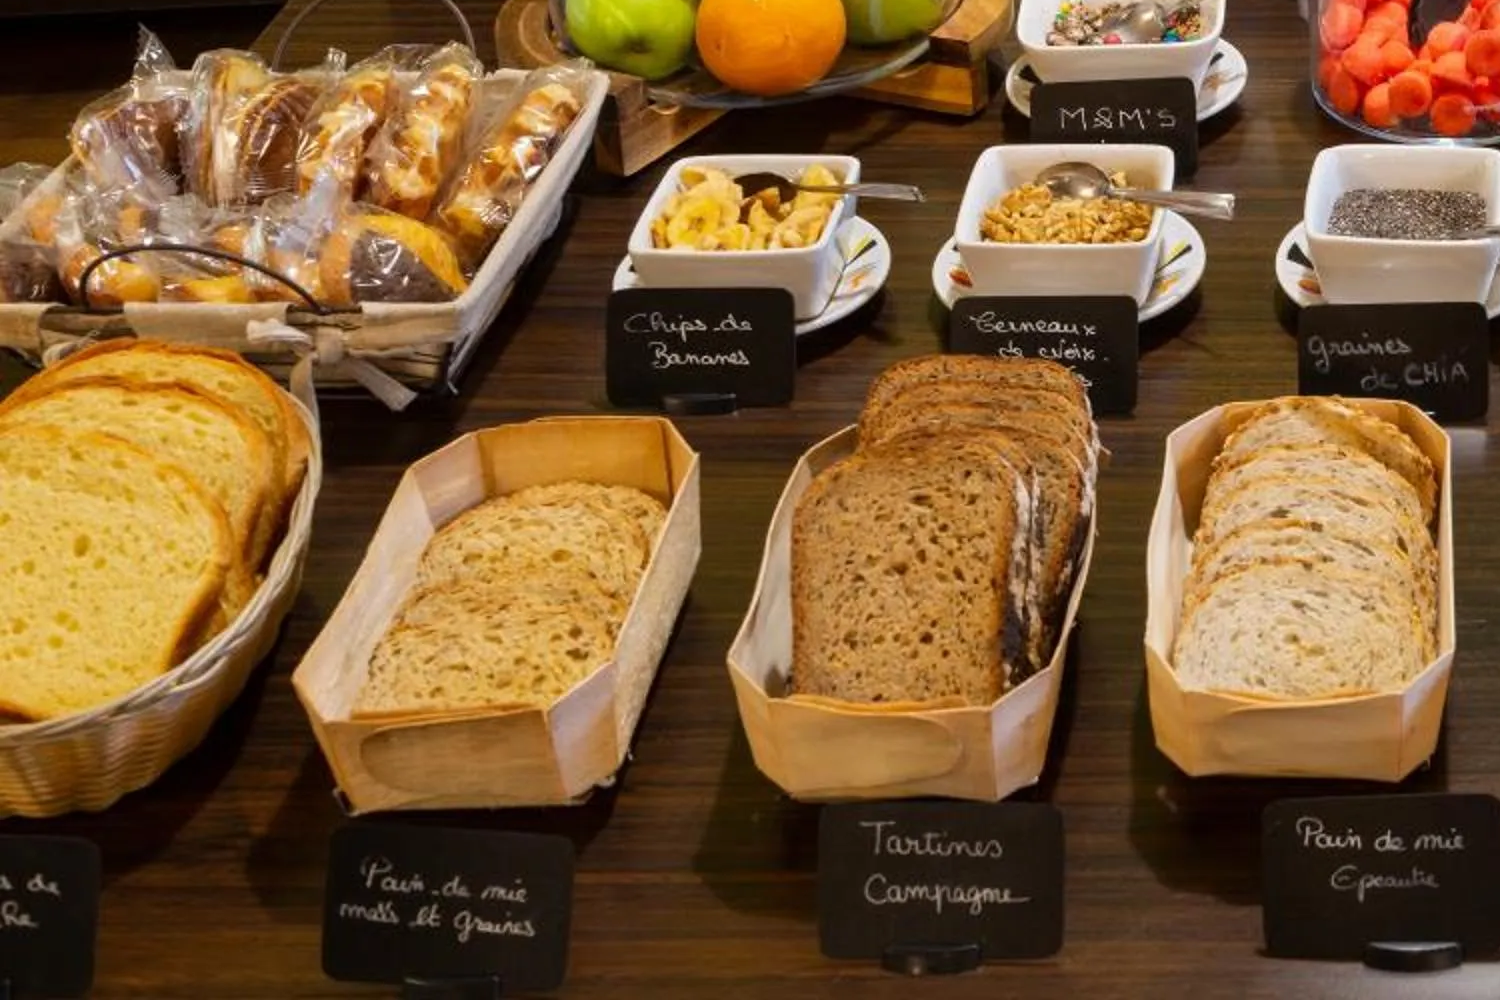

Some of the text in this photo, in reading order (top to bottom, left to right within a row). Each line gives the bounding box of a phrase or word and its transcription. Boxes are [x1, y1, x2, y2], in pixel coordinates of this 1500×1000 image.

[649, 341, 750, 369] Bananes
[859, 820, 1003, 857] Tartines
[1296, 816, 1466, 852] Pain de mie
[360, 855, 424, 891] Pain
[481, 879, 528, 902] mie
[864, 873, 1031, 915] Campagne
